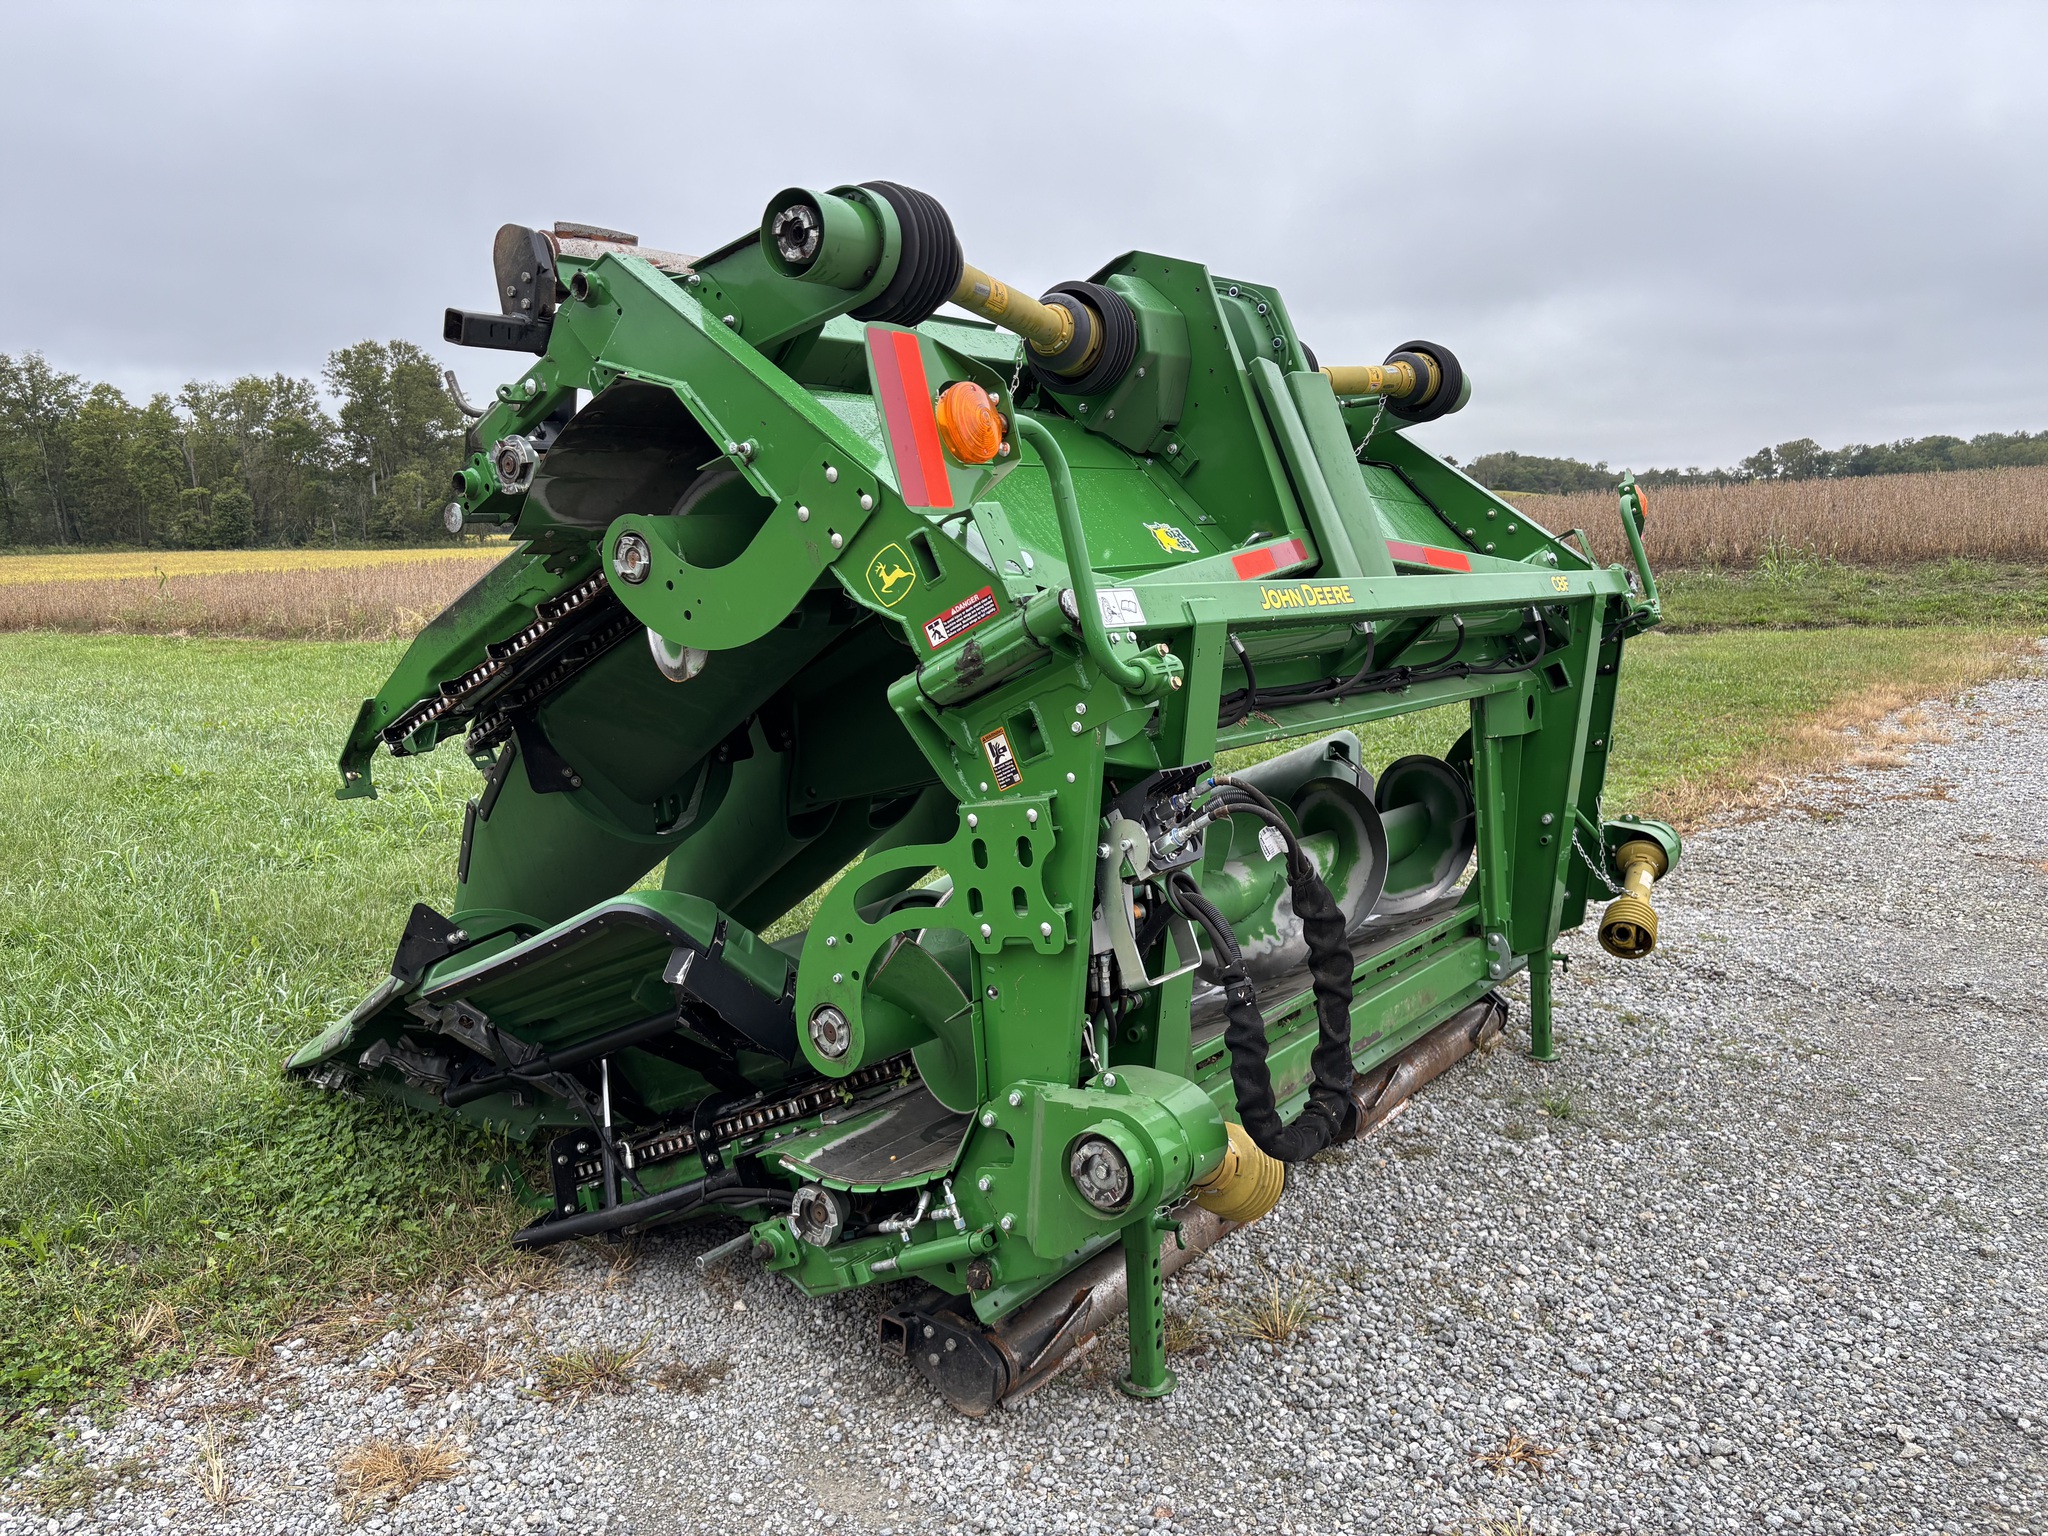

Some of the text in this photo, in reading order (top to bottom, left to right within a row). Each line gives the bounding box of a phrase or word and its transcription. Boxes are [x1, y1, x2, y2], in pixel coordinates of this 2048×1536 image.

[1550, 575, 1569, 592] C8F
[955, 594, 980, 613] DANGER
[1260, 583, 1355, 610] JOHN DEERE
